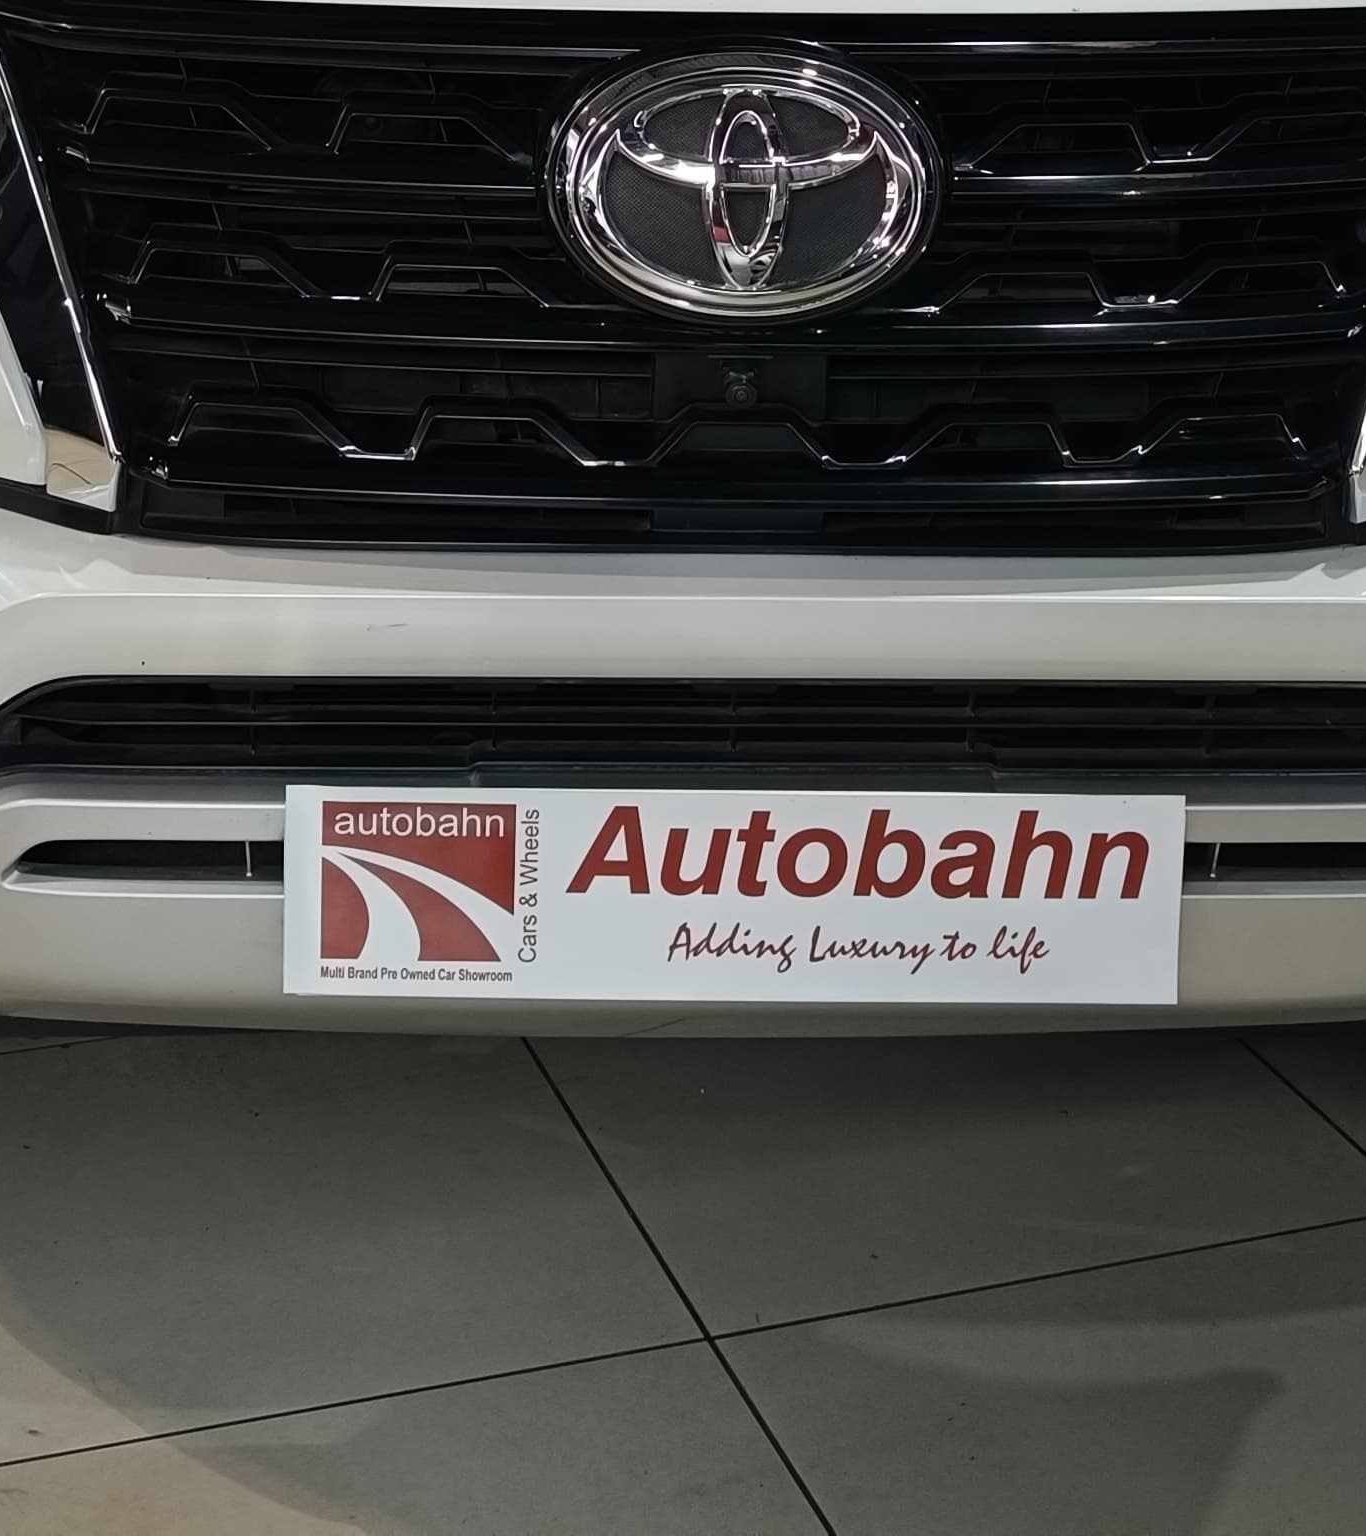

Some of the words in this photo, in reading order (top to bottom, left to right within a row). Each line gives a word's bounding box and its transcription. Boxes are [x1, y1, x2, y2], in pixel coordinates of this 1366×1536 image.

[334, 806, 504, 837] autobahn
[519, 809, 540, 886] Wheels
[565, 805, 1151, 899] Autobahn
[519, 893, 538, 907] &
[518, 914, 538, 963] Cars
[668, 922, 797, 973] Adding
[809, 925, 935, 974] Luxury
[939, 930, 977, 961] to
[987, 925, 1052, 974] life
[320, 965, 345, 979] Multi
[347, 966, 378, 980] Brand
[380, 967, 398, 980] Pre
[400, 968, 435, 981] Owned
[438, 968, 456, 981] Car
[458, 969, 513, 982] Showroom
